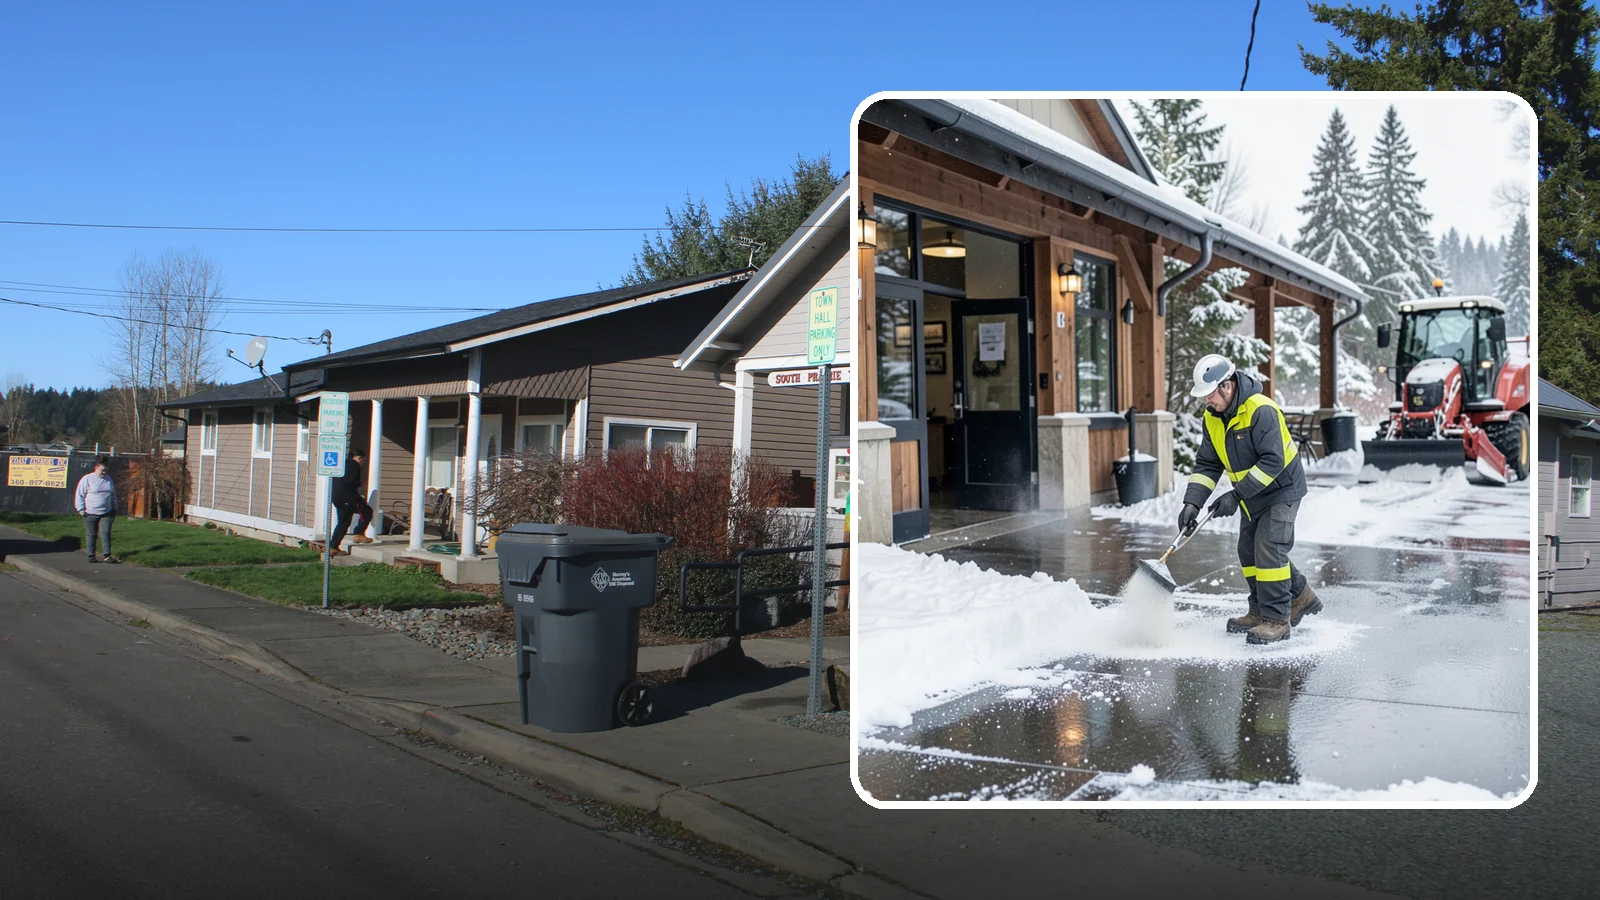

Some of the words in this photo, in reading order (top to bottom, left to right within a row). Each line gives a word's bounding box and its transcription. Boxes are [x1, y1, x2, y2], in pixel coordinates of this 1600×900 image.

[815, 294, 833, 308] TOWN
[815, 311, 831, 324] HALL
[810, 326, 836, 340] PARKING
[813, 343, 831, 357] ONLY
[775, 373, 801, 384] SOUTH
[323, 409, 345, 417] PARKING
[325, 420, 340, 428] ONLY
